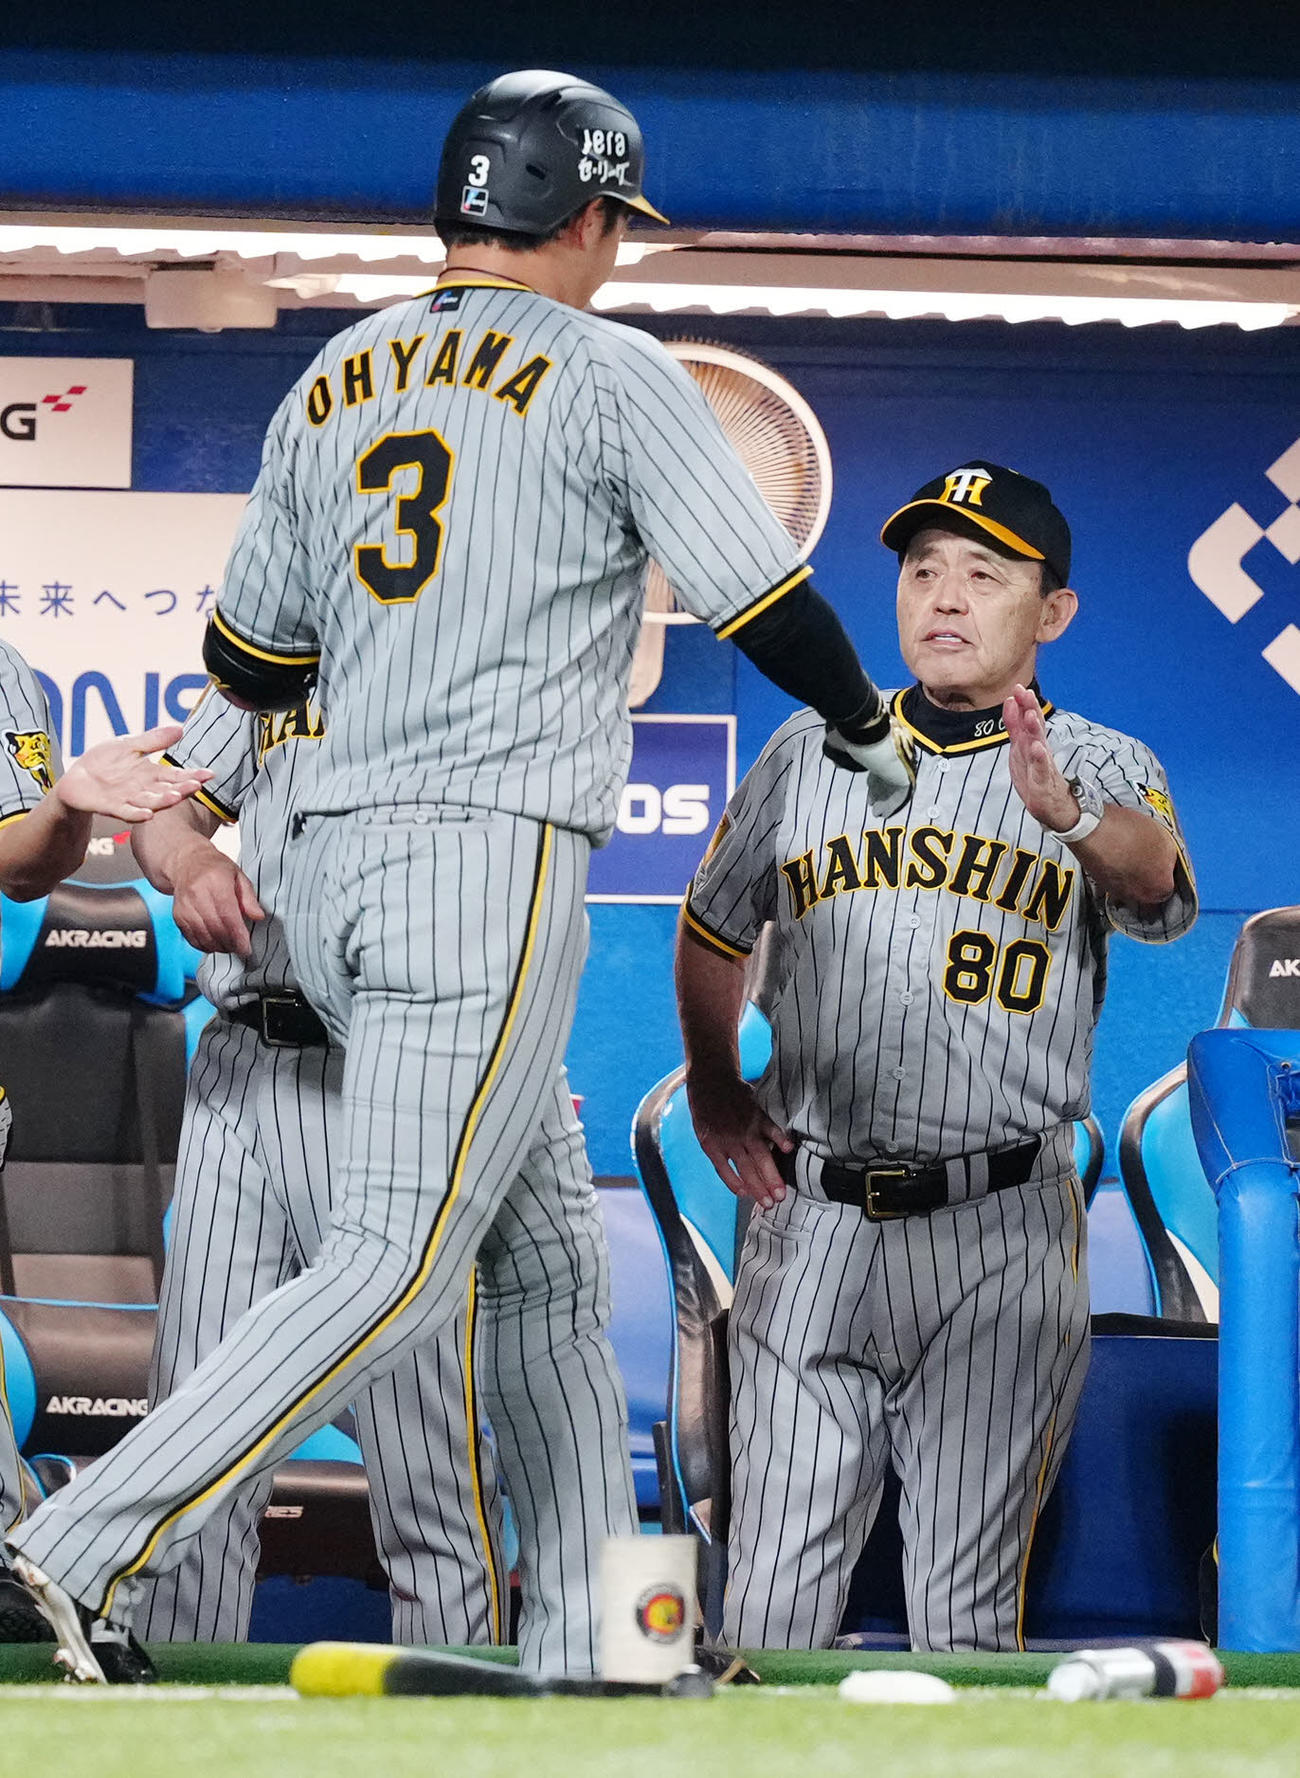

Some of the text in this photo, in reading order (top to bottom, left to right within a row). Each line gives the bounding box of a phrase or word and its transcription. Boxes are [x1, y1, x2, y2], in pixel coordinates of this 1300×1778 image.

[468, 154, 491, 187] 3
[306, 328, 554, 428] OHYAMA
[353, 427, 454, 605] 3
[974, 719, 995, 737] 80
[780, 824, 1076, 932] HANSHIN
[45, 929, 149, 948] AKRACING
[941, 929, 1053, 1016] 80
[45, 1395, 149, 1417] AKRACING
